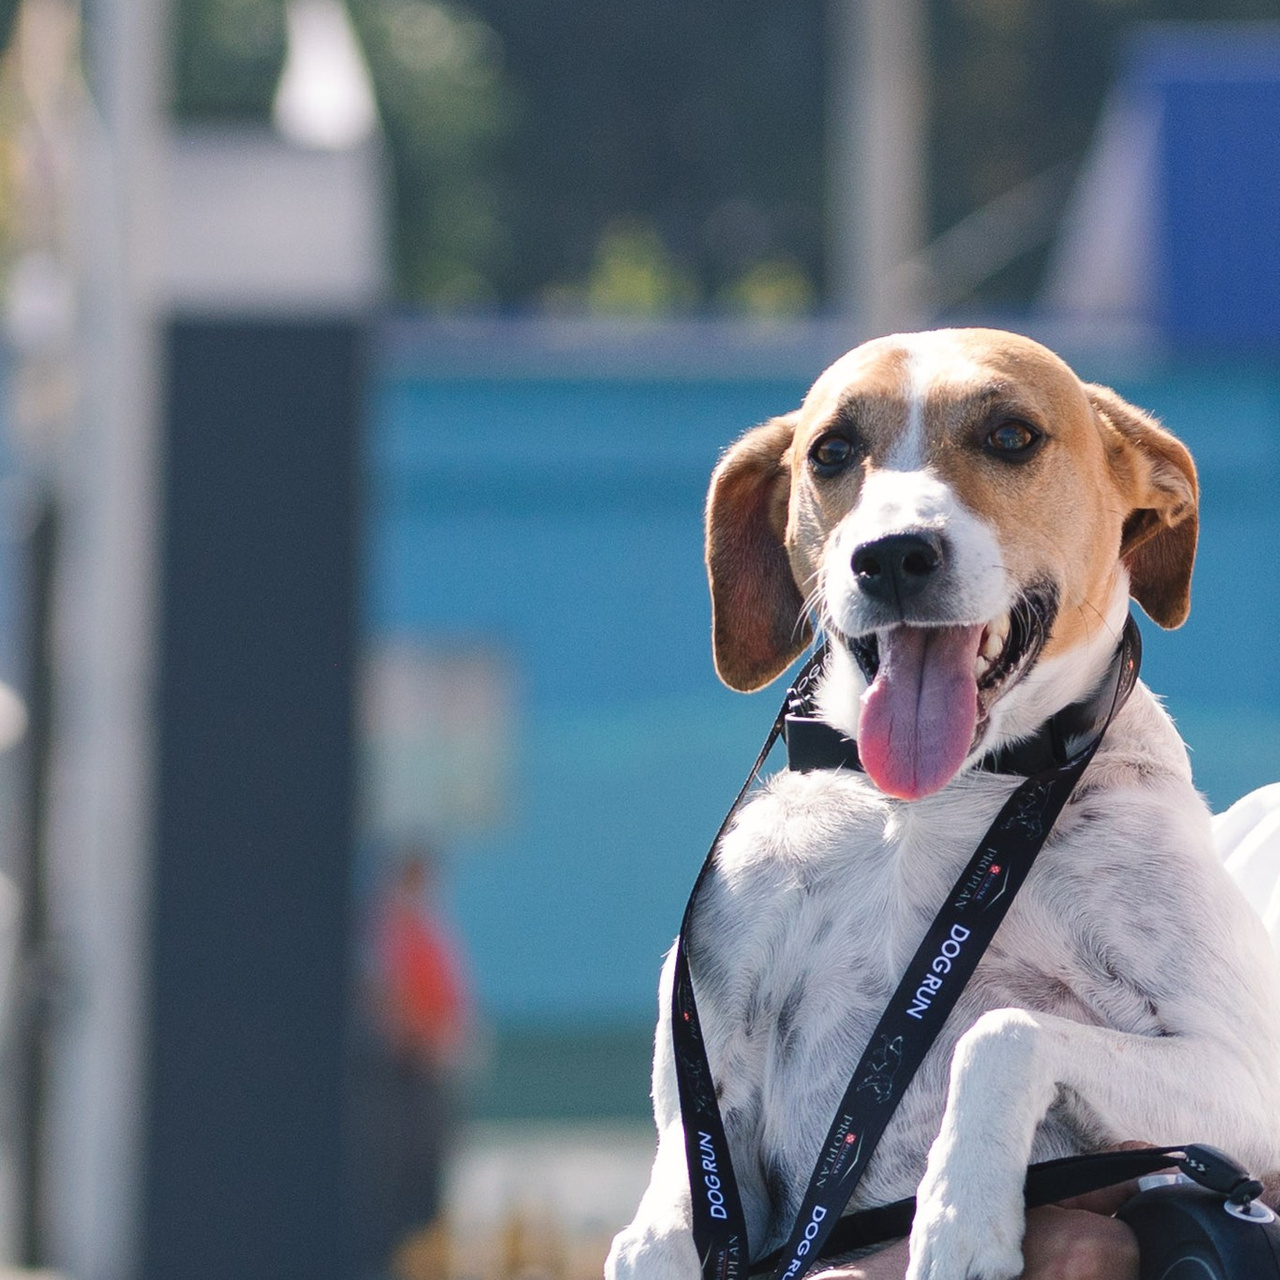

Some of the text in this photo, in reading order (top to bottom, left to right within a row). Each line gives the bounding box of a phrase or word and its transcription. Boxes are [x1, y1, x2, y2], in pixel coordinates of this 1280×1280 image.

[905, 923, 971, 1020] DOG RUN
[698, 1131, 728, 1220] DOG RUN
[796, 1204, 828, 1256] DOG
